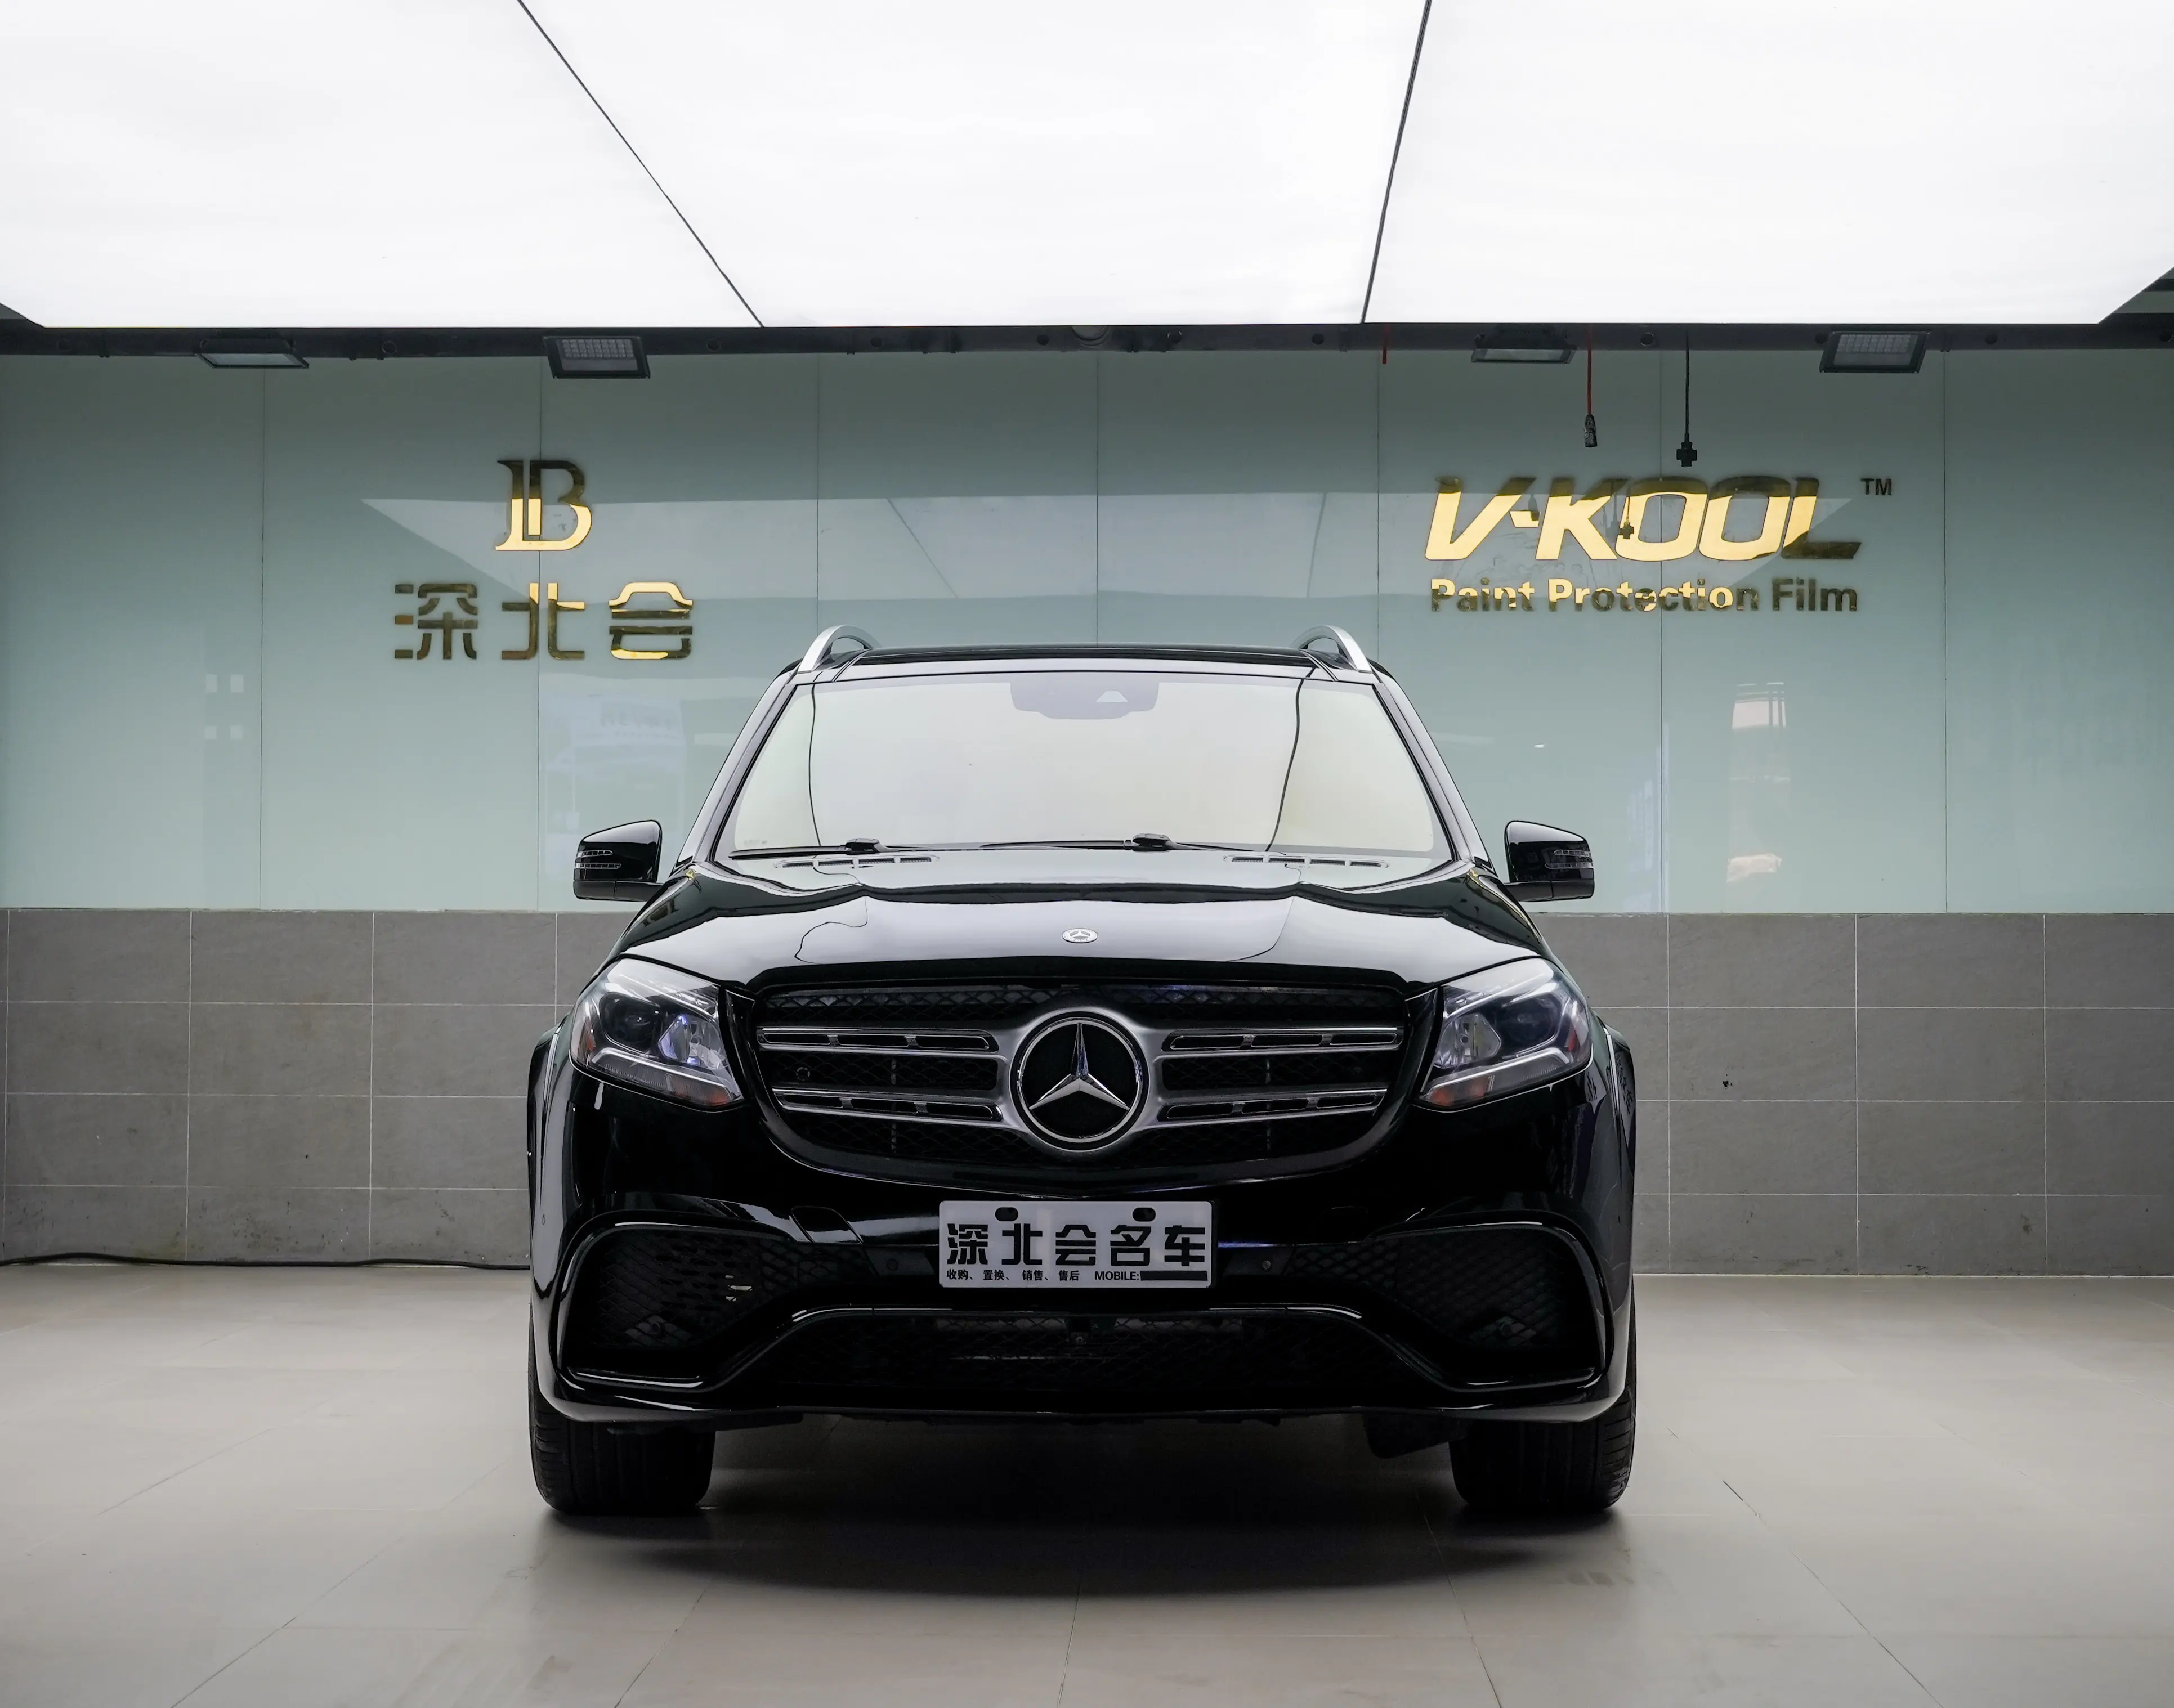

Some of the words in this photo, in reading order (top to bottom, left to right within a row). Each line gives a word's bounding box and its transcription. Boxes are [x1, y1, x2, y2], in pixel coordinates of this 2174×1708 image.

[1425, 476, 1862, 562] V-KOOL
[1430, 577, 1535, 612] Paint
[1548, 577, 1759, 612] Protection
[1771, 577, 1859, 612] Film
[394, 581, 694, 660] 深北会
[947, 1223, 1206, 1267] 深北会名车
[1094, 1272, 1140, 1281] MOBILE:
